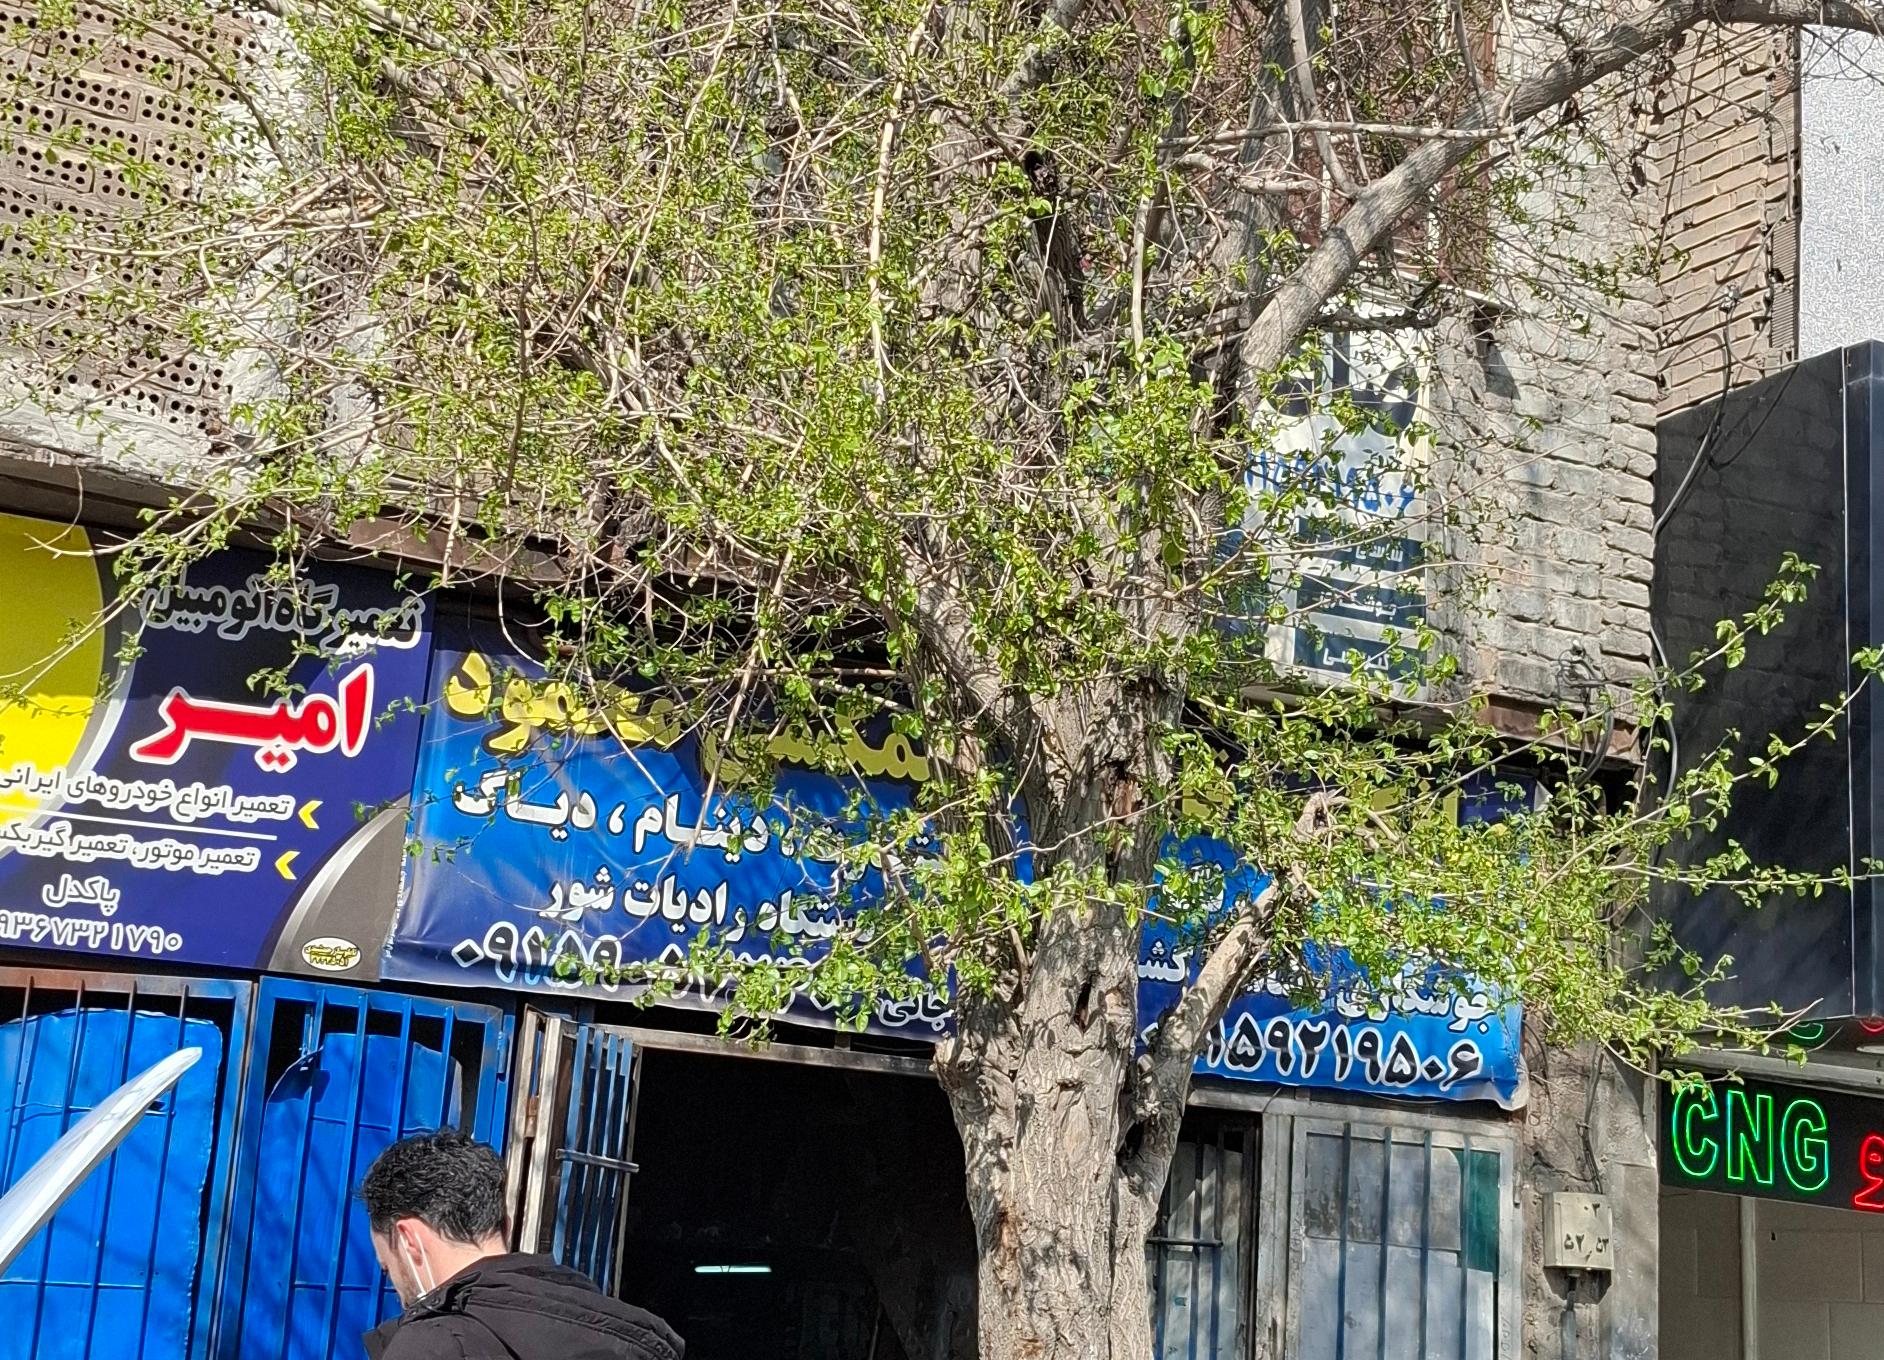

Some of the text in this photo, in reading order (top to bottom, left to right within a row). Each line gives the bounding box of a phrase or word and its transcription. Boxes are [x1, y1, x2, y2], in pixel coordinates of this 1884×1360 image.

[130, 664, 374, 773] امیر
[68, 774, 172, 804] خودروهای
[178, 787, 228, 817] انواع
[452, 769, 598, 841] دیاگ
[236, 798, 291, 817] تعمیر
[0, 822, 67, 852] گیربک
[69, 838, 128, 857] تعمیر
[199, 849, 256, 870] تعمیر
[46, 877, 118, 912] پاکدل
[539, 866, 615, 923] شور
[622, 874, 748, 943] رادیات
[1672, 1083, 1829, 1191] CNG
